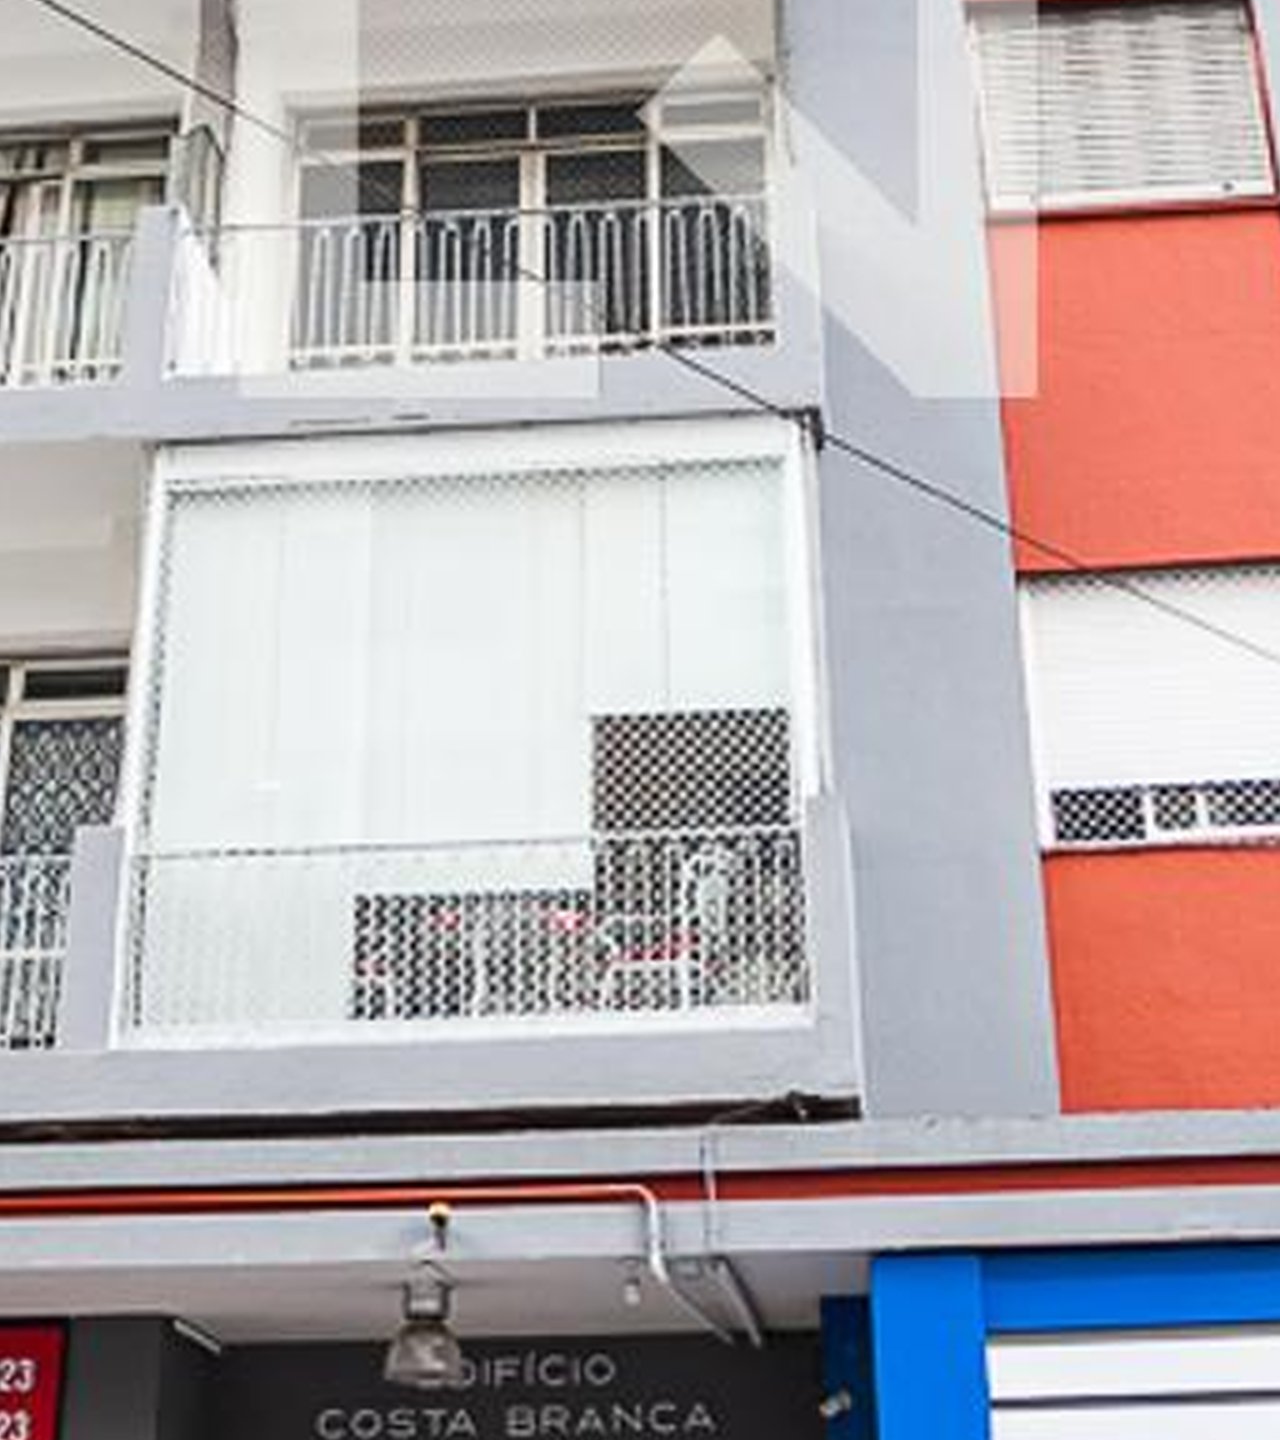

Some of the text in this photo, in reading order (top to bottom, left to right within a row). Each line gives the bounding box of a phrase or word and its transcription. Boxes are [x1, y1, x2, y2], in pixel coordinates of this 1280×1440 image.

[458, 1350, 617, 1387] DIFÍCIO
[317, 1403, 718, 1440] COSTA BRANCA
